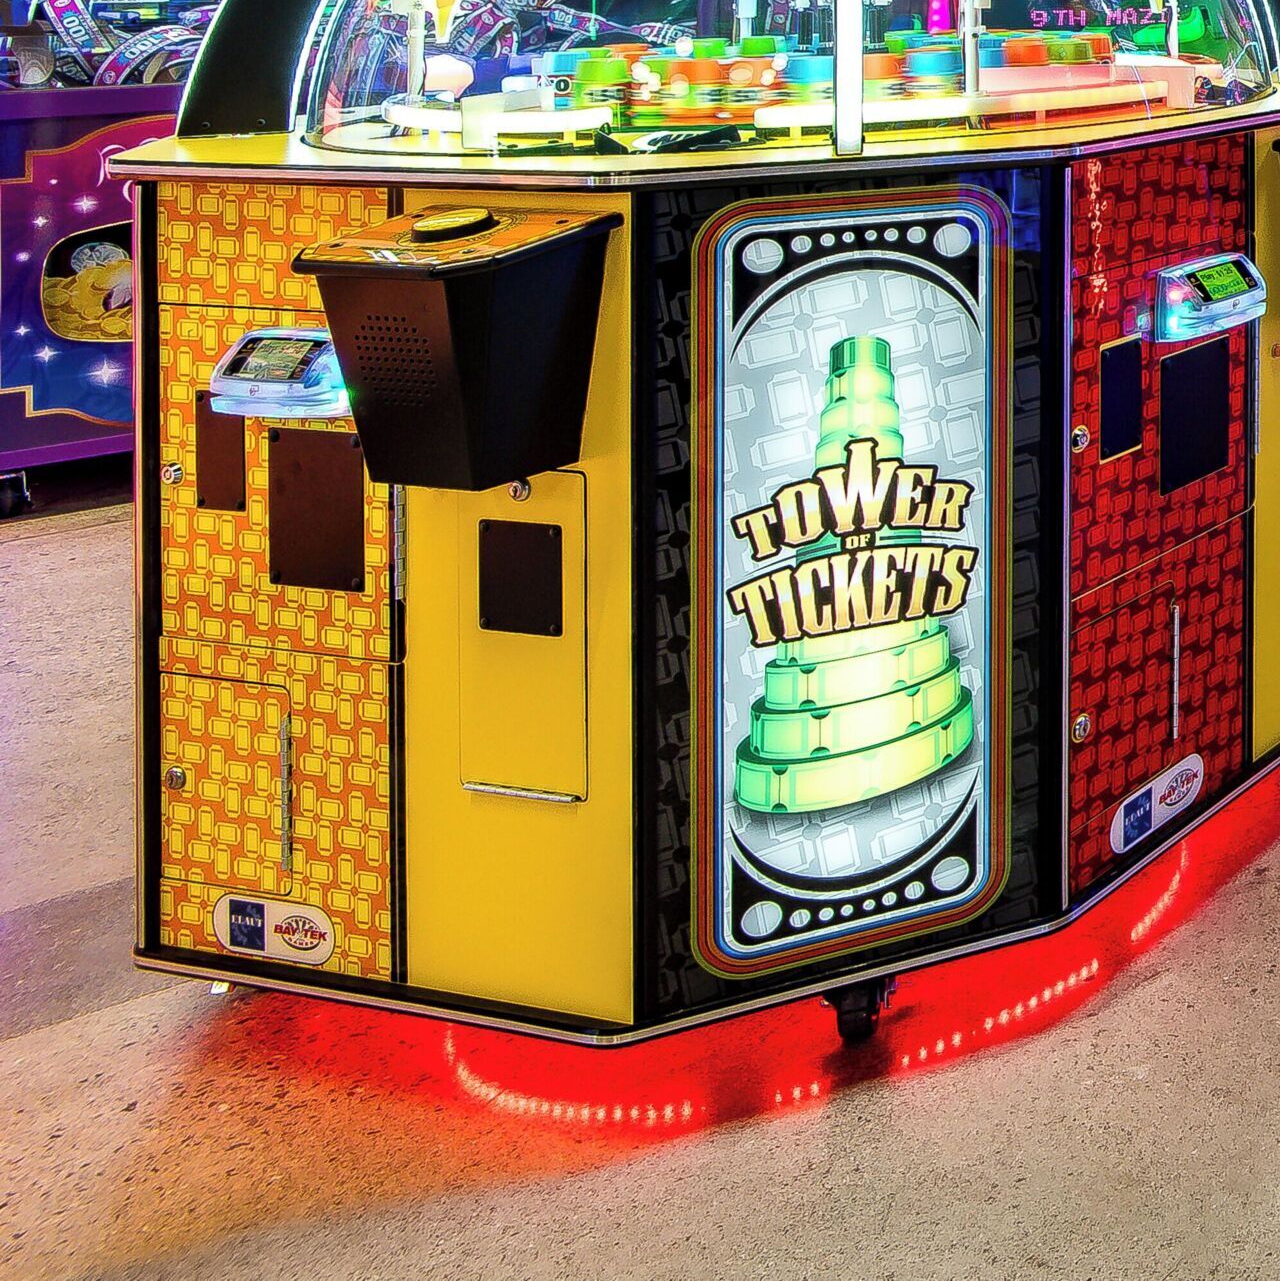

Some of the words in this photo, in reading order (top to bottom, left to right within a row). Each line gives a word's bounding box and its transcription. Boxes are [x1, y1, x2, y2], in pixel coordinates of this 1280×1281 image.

[1030, 9, 1086, 27] 9TH
[732, 438, 975, 561] TOWER
[845, 532, 872, 549] OF
[728, 546, 980, 646] TICKETS
[273, 924, 298, 937] BAY
[303, 929, 328, 941] TEK
